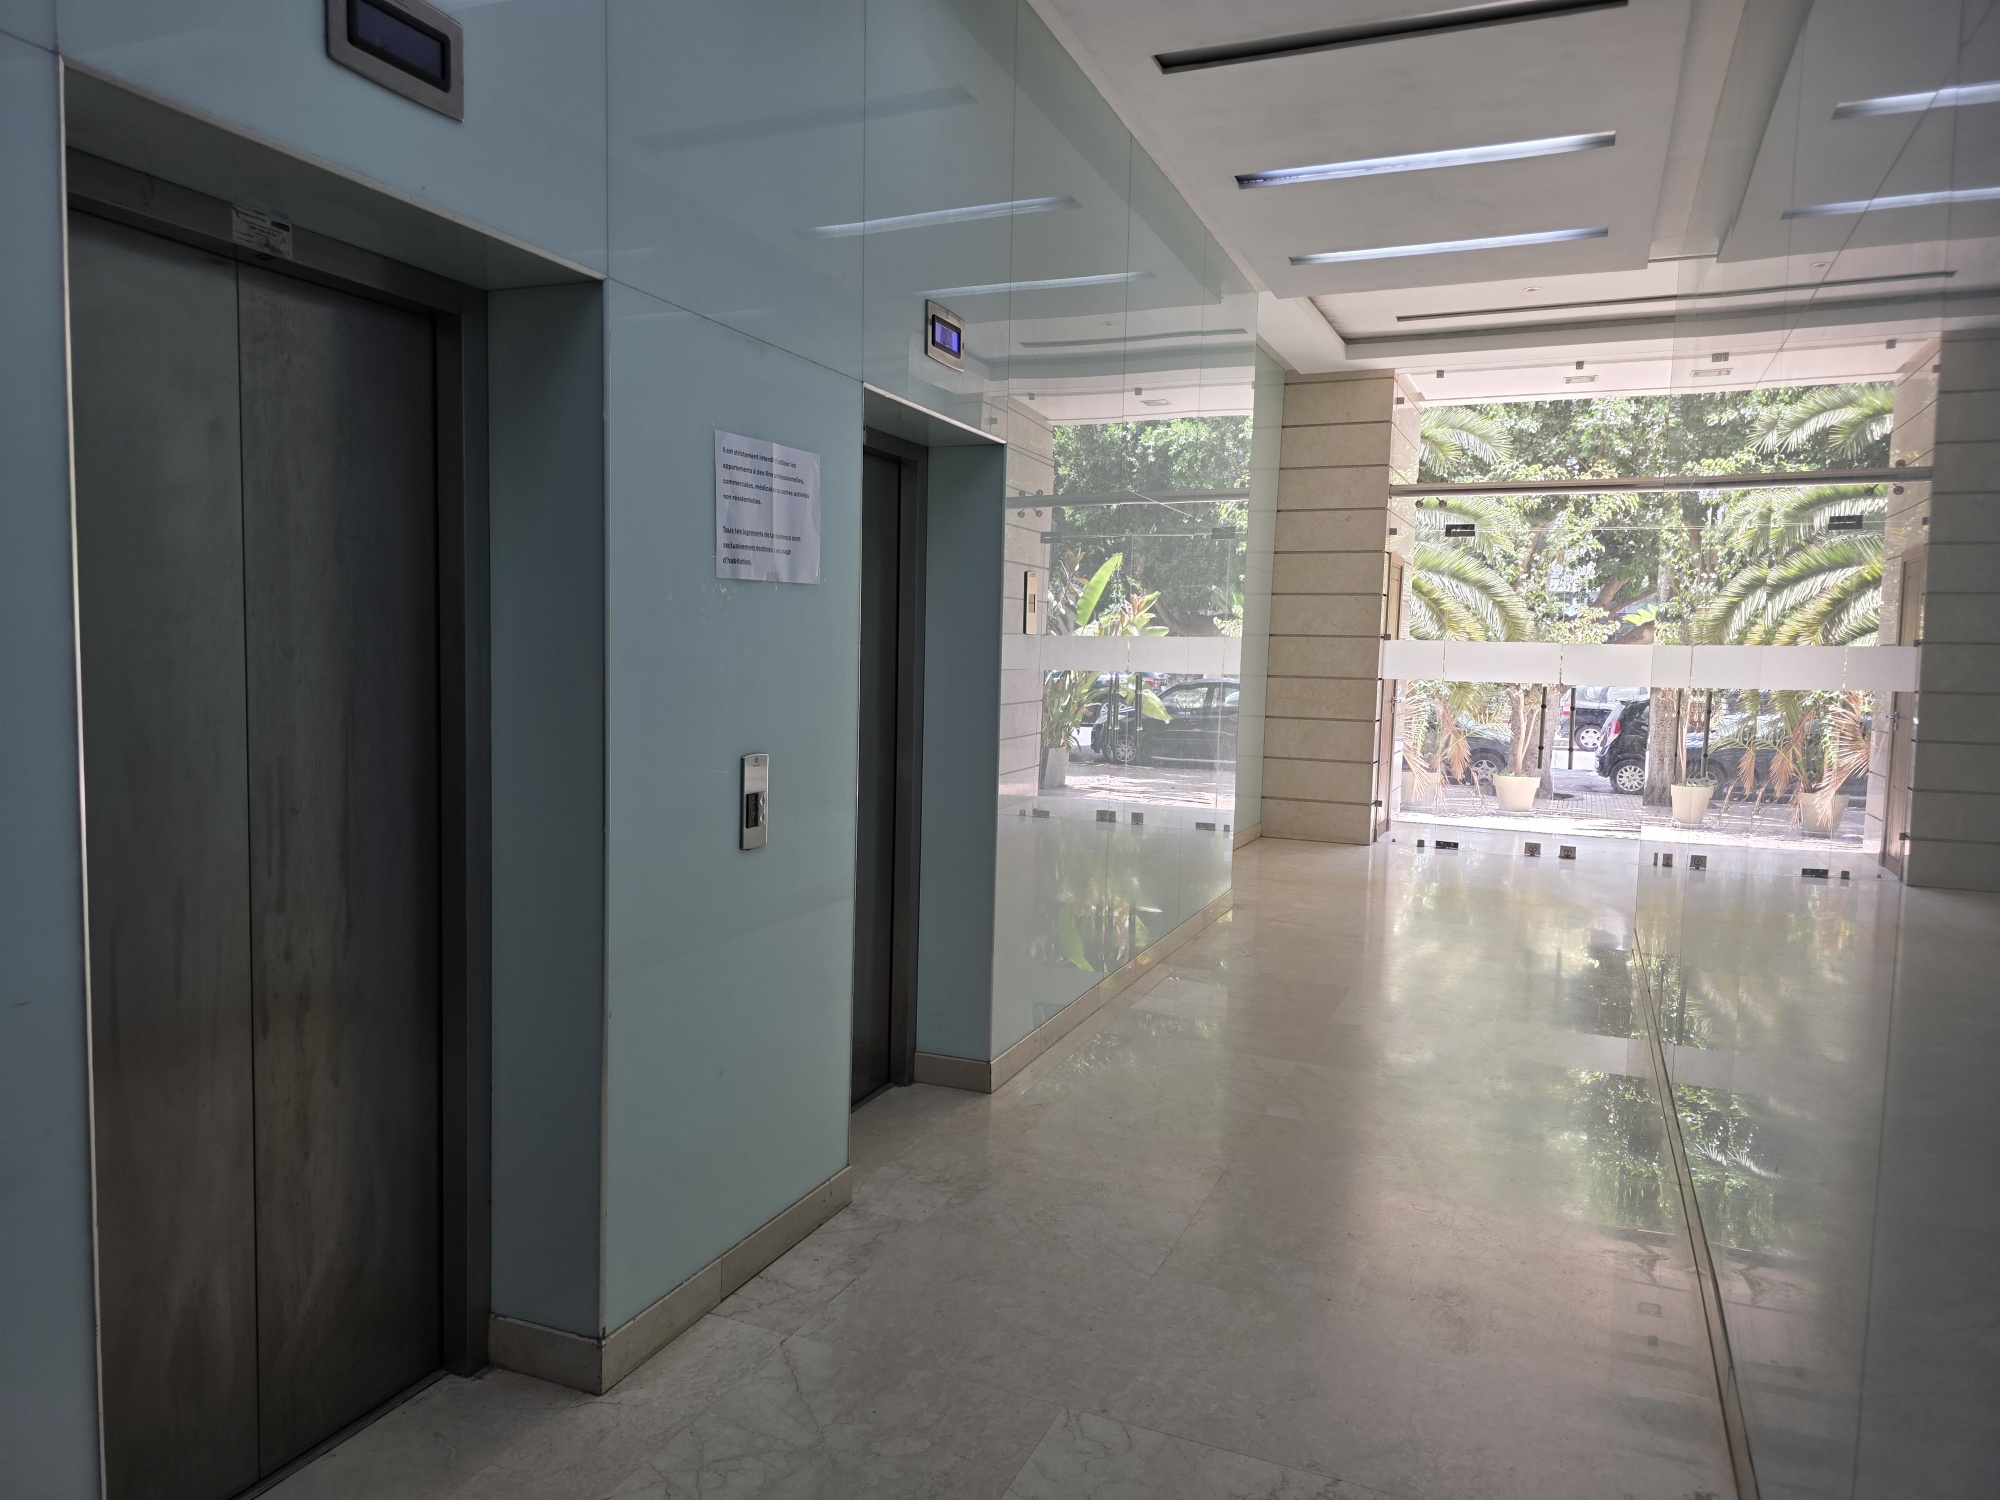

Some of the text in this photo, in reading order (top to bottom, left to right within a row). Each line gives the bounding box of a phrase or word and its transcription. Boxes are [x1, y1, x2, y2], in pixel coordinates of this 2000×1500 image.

[734, 450, 758, 460] strictement
[723, 463, 752, 474] appartements
[765, 470, 774, 478] fins
[723, 478, 754, 490] commerciales,
[781, 489, 794, 497] autres
[794, 491, 810, 499] activités
[732, 494, 762, 505] résidentielles.
[723, 525, 734, 534] Tous
[734, 527, 742, 535] les
[742, 529, 764, 538] logements
[770, 531, 774, 539] la
[723, 542, 756, 552] exclusivement
[723, 556, 752, 566] d'habitation.
